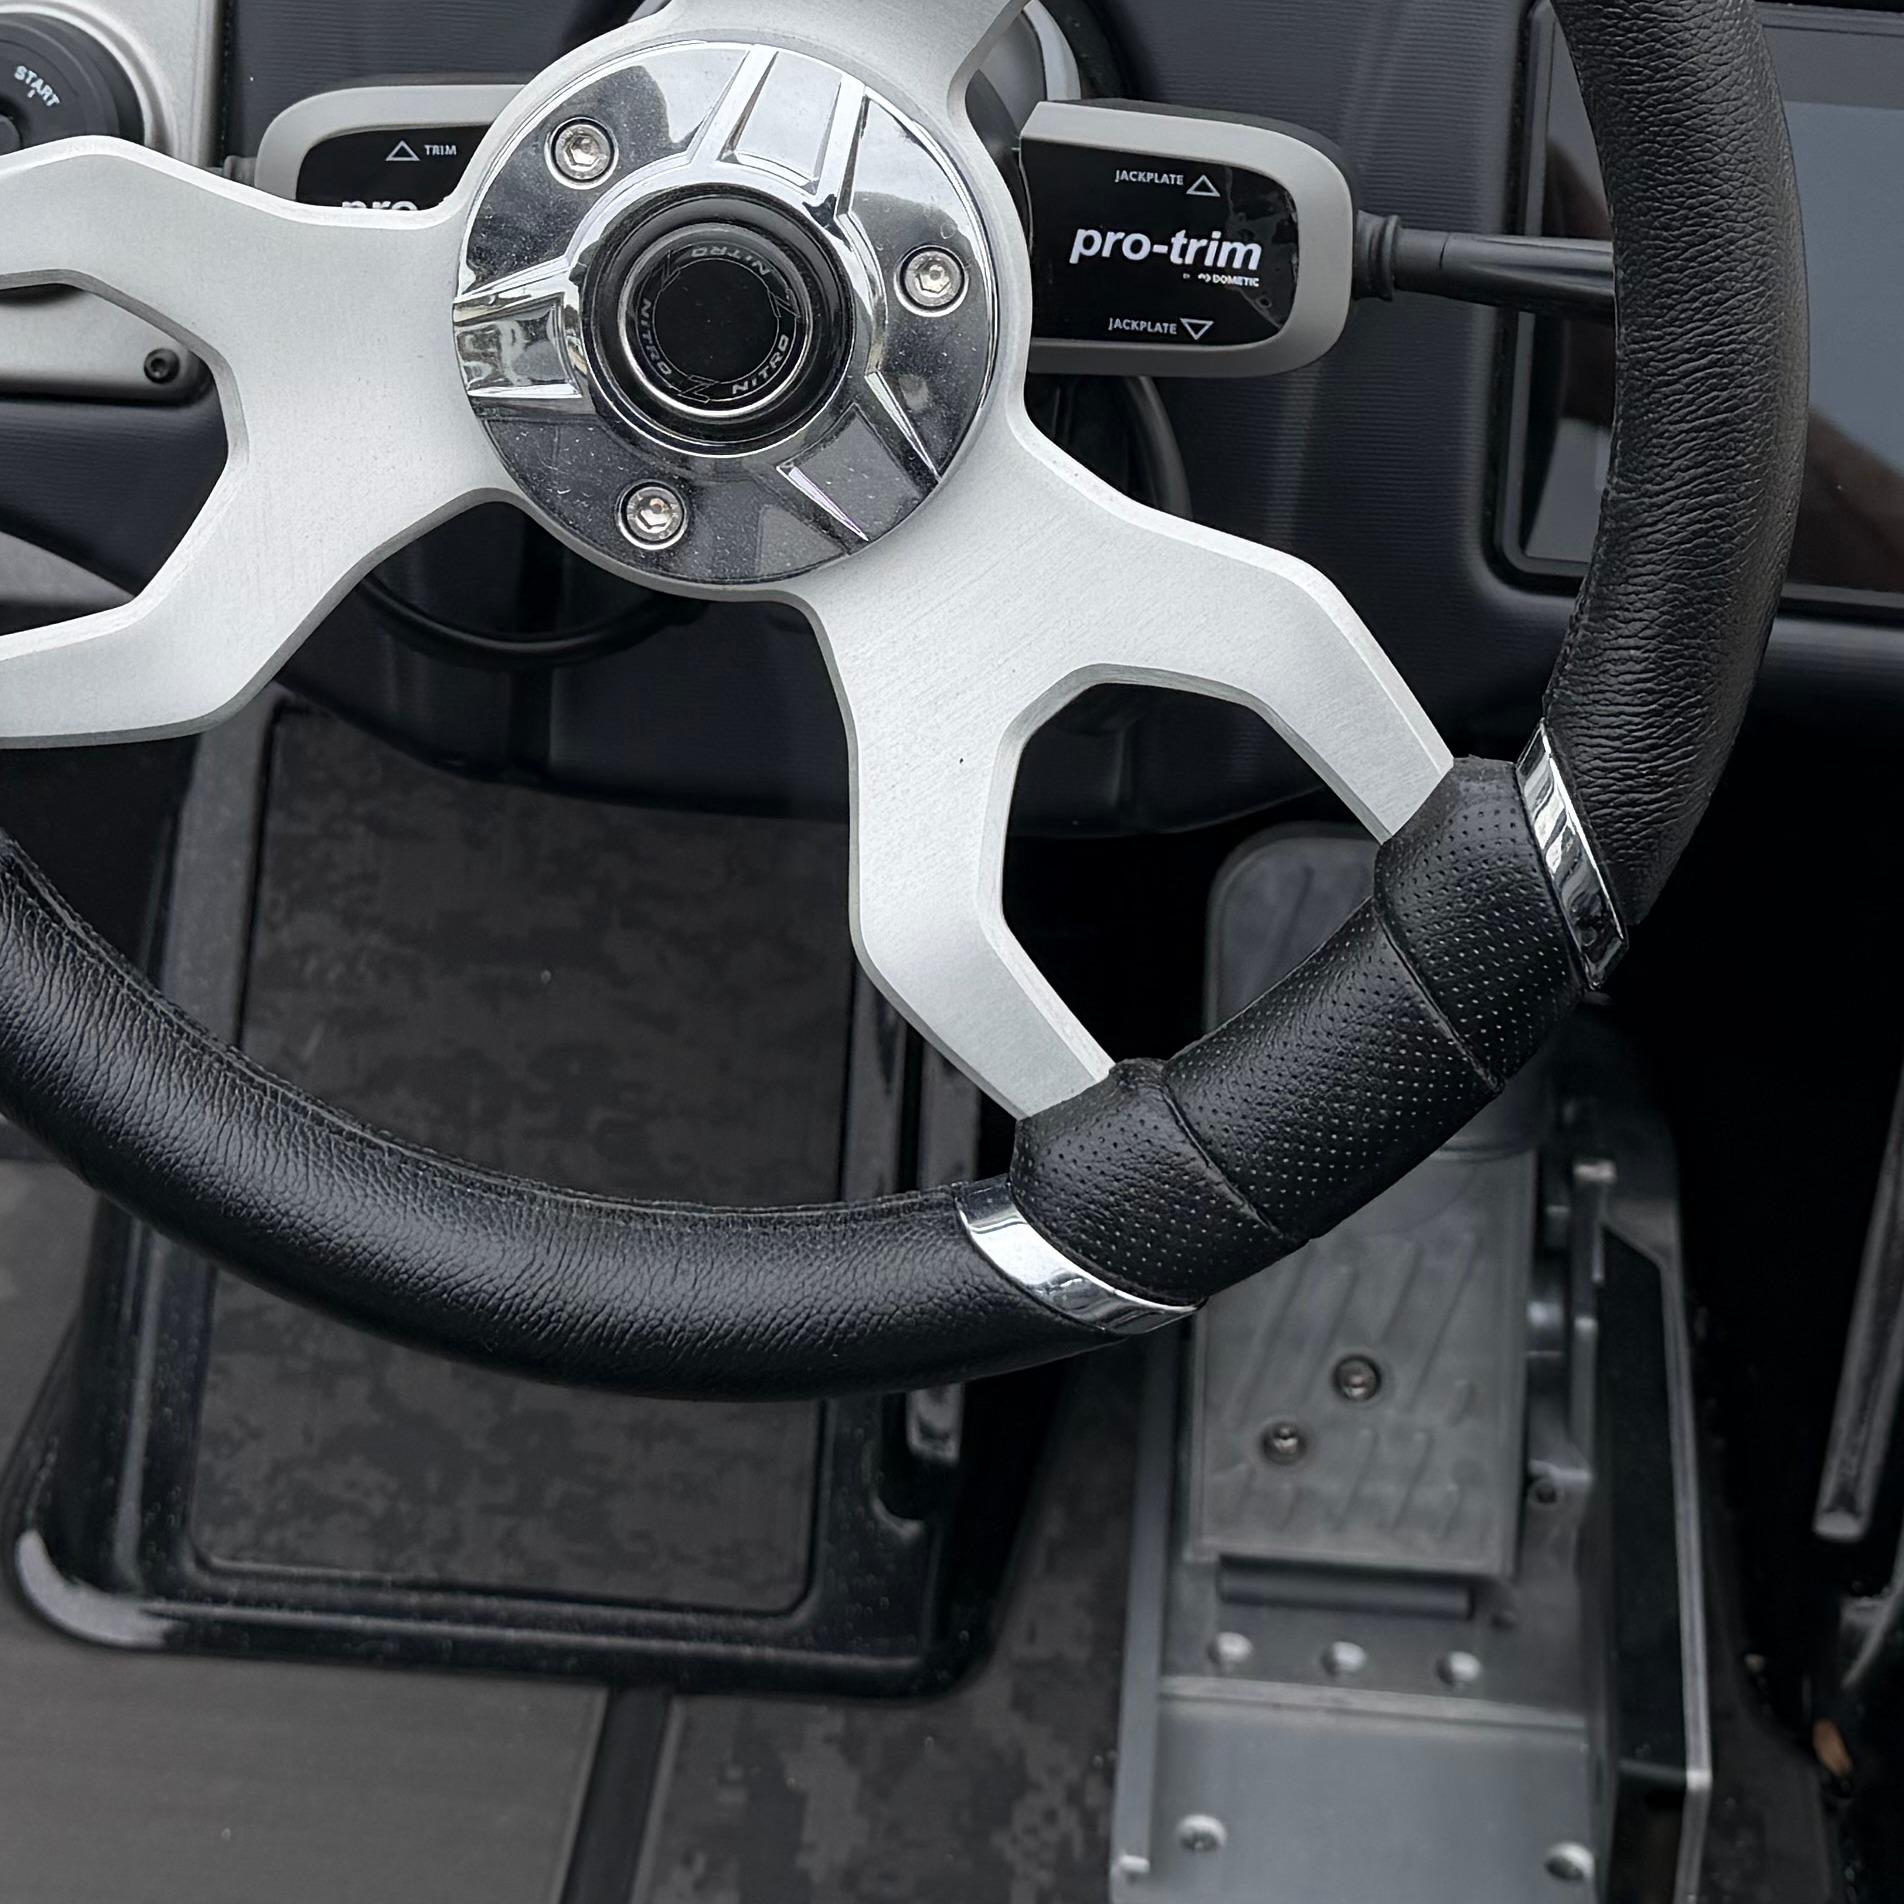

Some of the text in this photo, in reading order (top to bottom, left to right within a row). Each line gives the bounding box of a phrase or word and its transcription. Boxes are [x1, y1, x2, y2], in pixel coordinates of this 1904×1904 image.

[13, 65, 62, 107] START
[423, 143, 457, 157] TRIM
[1114, 168, 1184, 186] JACKPLATE
[690, 243, 771, 277] NITRO
[1068, 227, 1263, 271] pro-trim
[1212, 273, 1260, 288] DOMETIC
[640, 298, 673, 377] NITRO
[1107, 316, 1177, 336] JACKPLATE
[731, 334, 790, 395] NITRO
